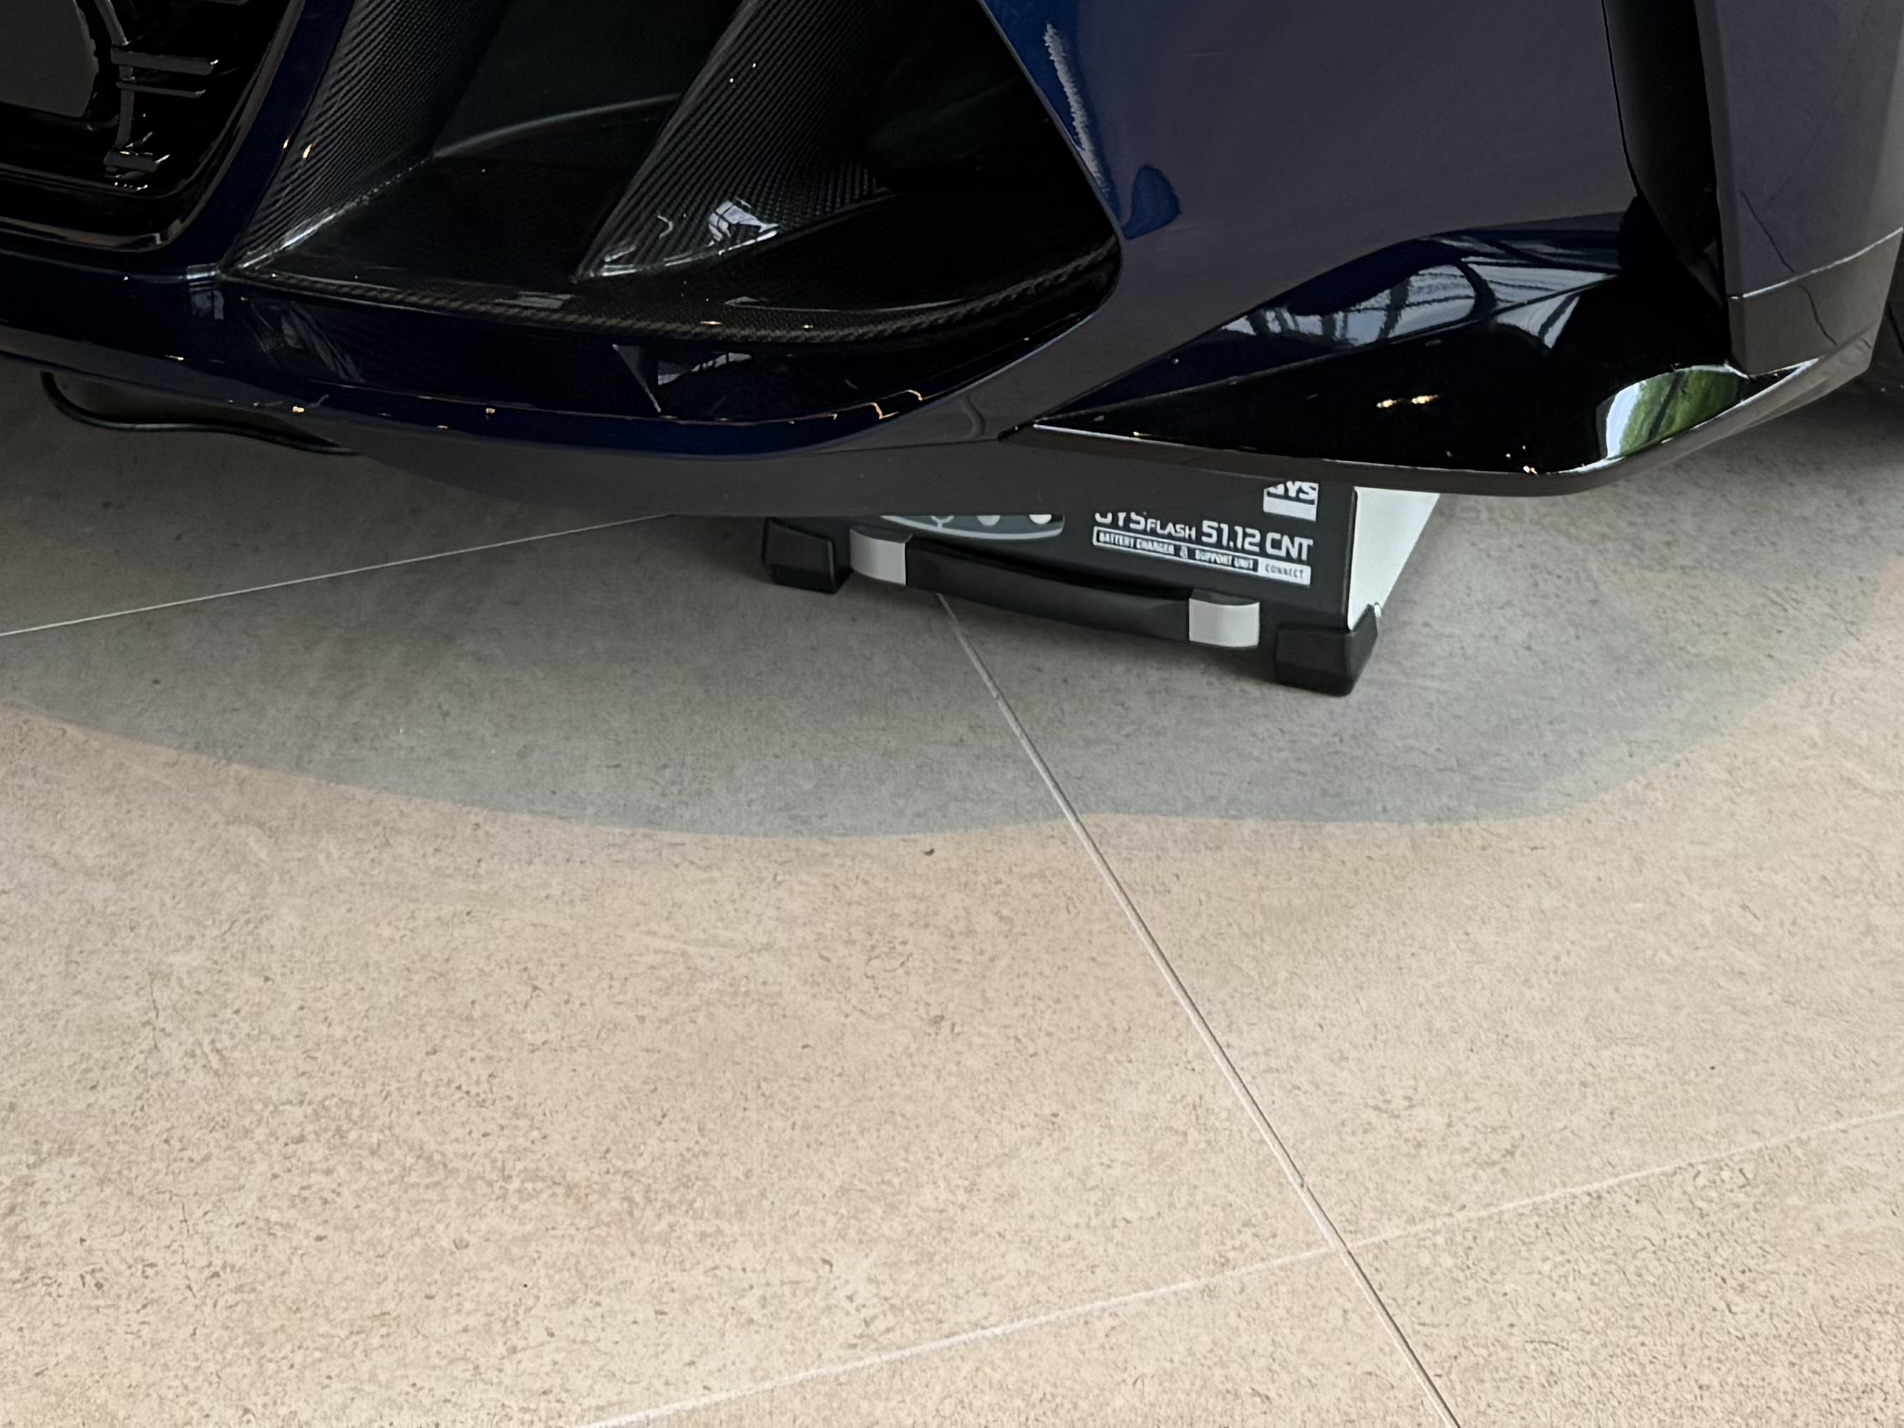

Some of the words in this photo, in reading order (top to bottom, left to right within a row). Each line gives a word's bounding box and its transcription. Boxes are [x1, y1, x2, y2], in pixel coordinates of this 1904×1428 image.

[1099, 531, 1135, 549] BATTERY
[1136, 538, 1175, 555] CHARGER
[1195, 549, 1233, 566] SUPPORT
[1234, 557, 1255, 571] UNIT
[1265, 562, 1304, 579] CONNECT
[1202, 520, 1261, 553] 51.12
[1265, 532, 1314, 561] CNT
